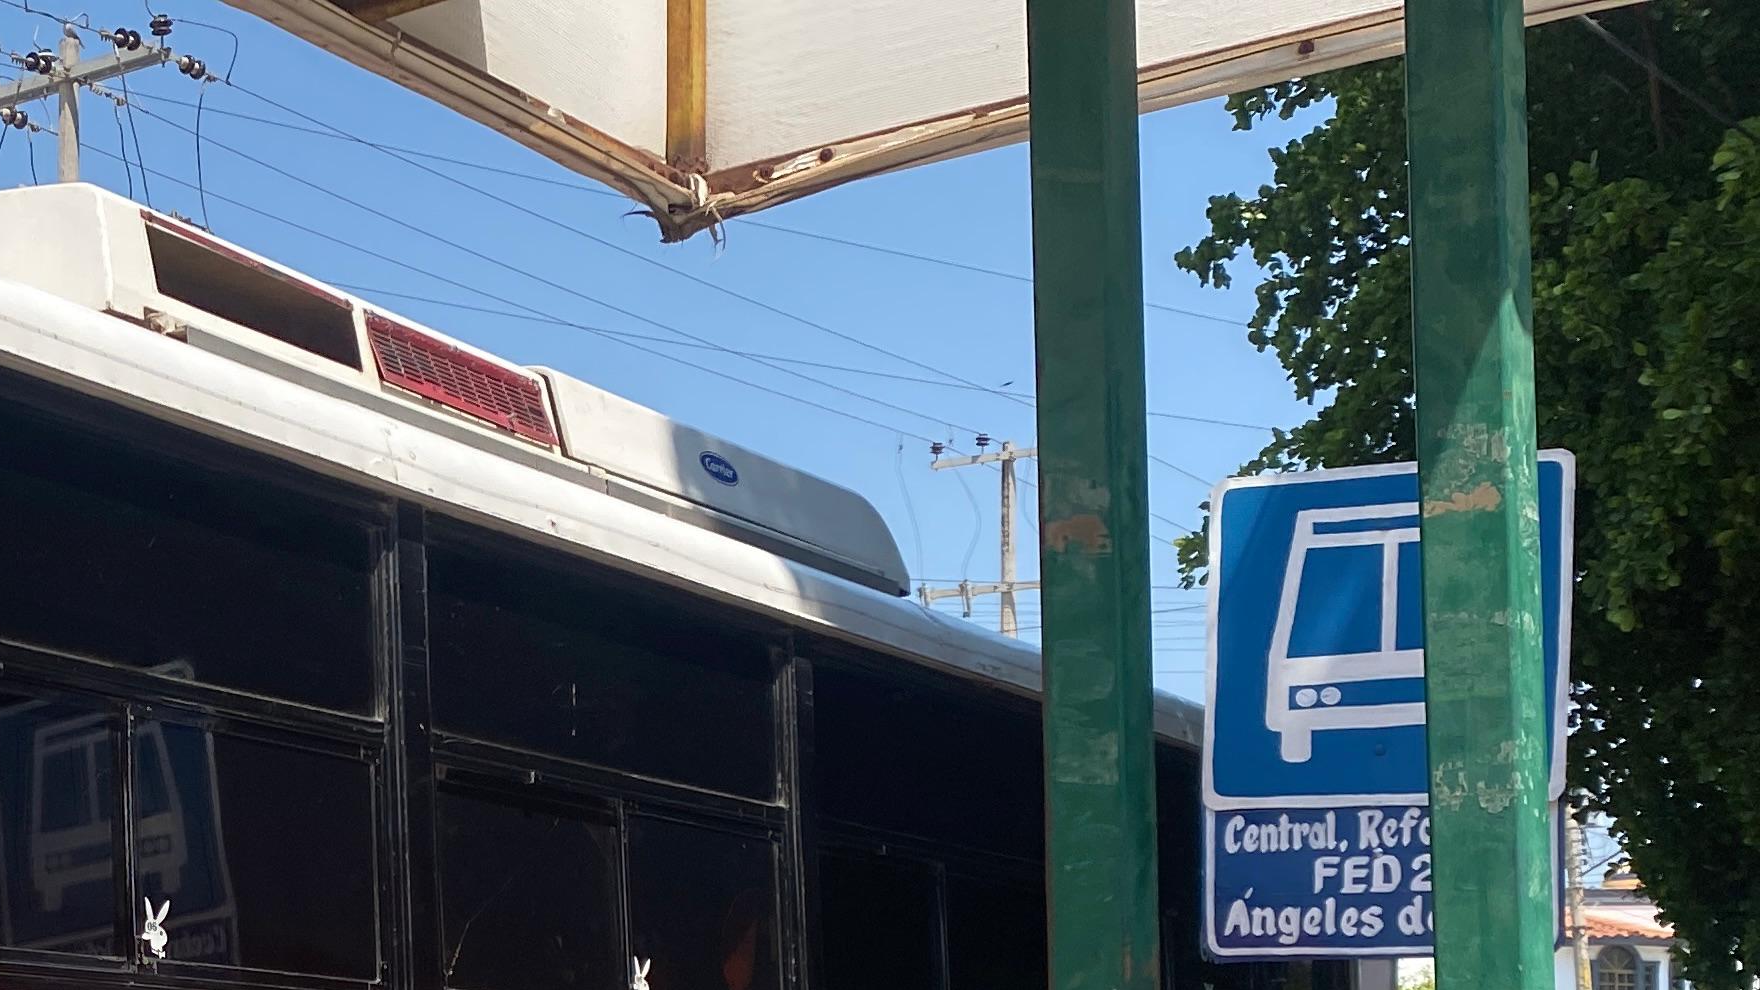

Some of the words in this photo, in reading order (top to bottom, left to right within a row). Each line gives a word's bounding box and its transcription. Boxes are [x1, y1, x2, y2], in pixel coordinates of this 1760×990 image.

[1224, 810, 1348, 853] Central,
[1314, 854, 1402, 894] FED
[1410, 853, 1432, 892] 2
[1224, 887, 1385, 945] Ángeles
